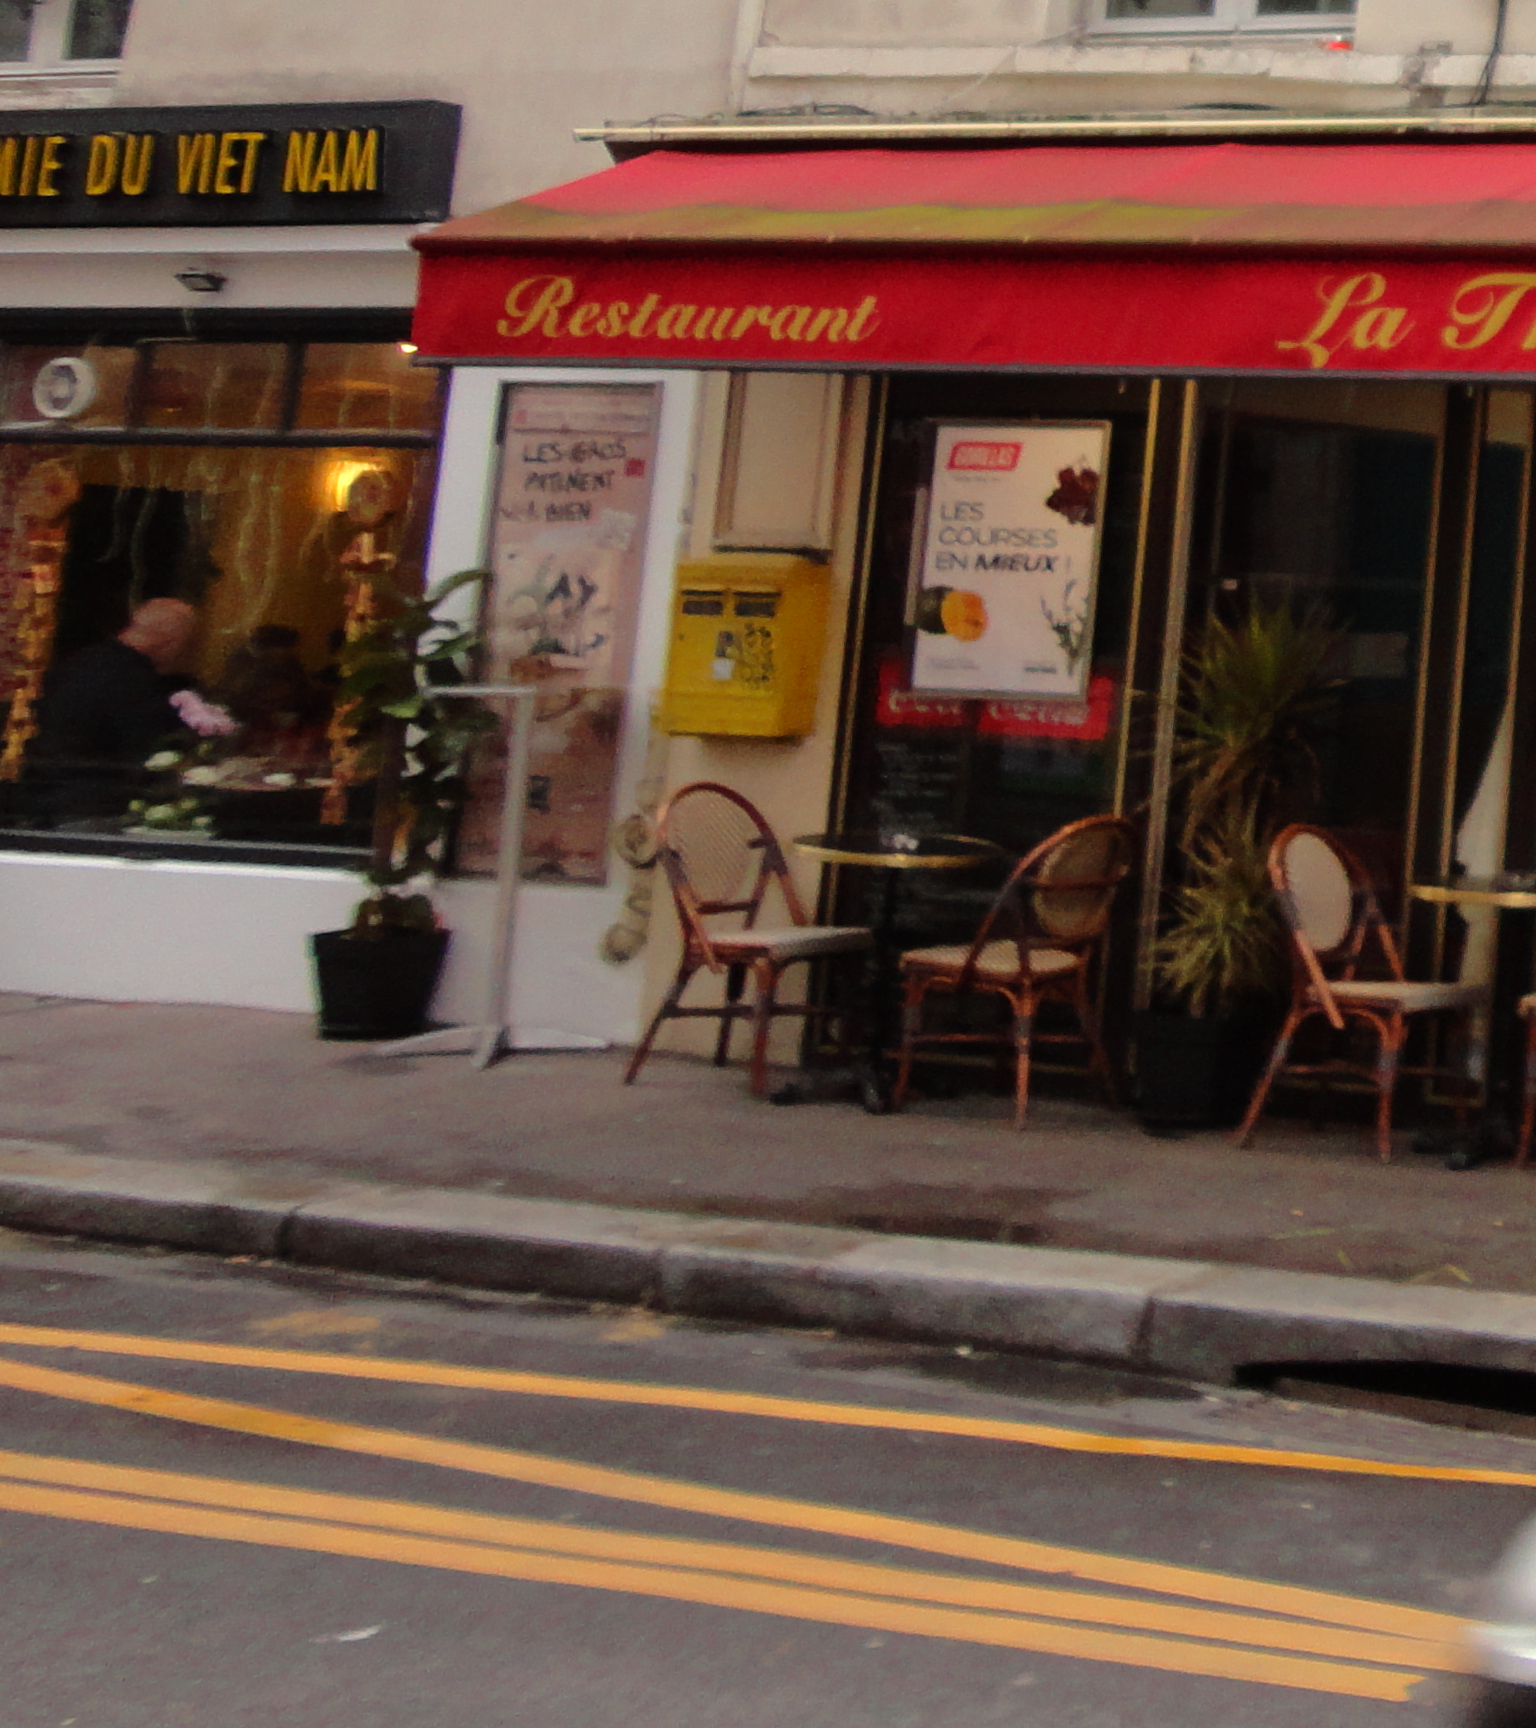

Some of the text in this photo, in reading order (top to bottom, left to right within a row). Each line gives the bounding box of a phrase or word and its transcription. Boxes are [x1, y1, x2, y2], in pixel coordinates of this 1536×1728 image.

[85, 134, 155, 196] DU
[176, 131, 268, 195] VIET
[281, 128, 379, 193] NAM
[496, 274, 883, 342] Restaurant
[1275, 272, 1416, 369] La
[941, 501, 984, 522] LES
[938, 526, 1058, 549] COURSES
[935, 553, 968, 572] EN
[974, 554, 1058, 573] MIEUX
